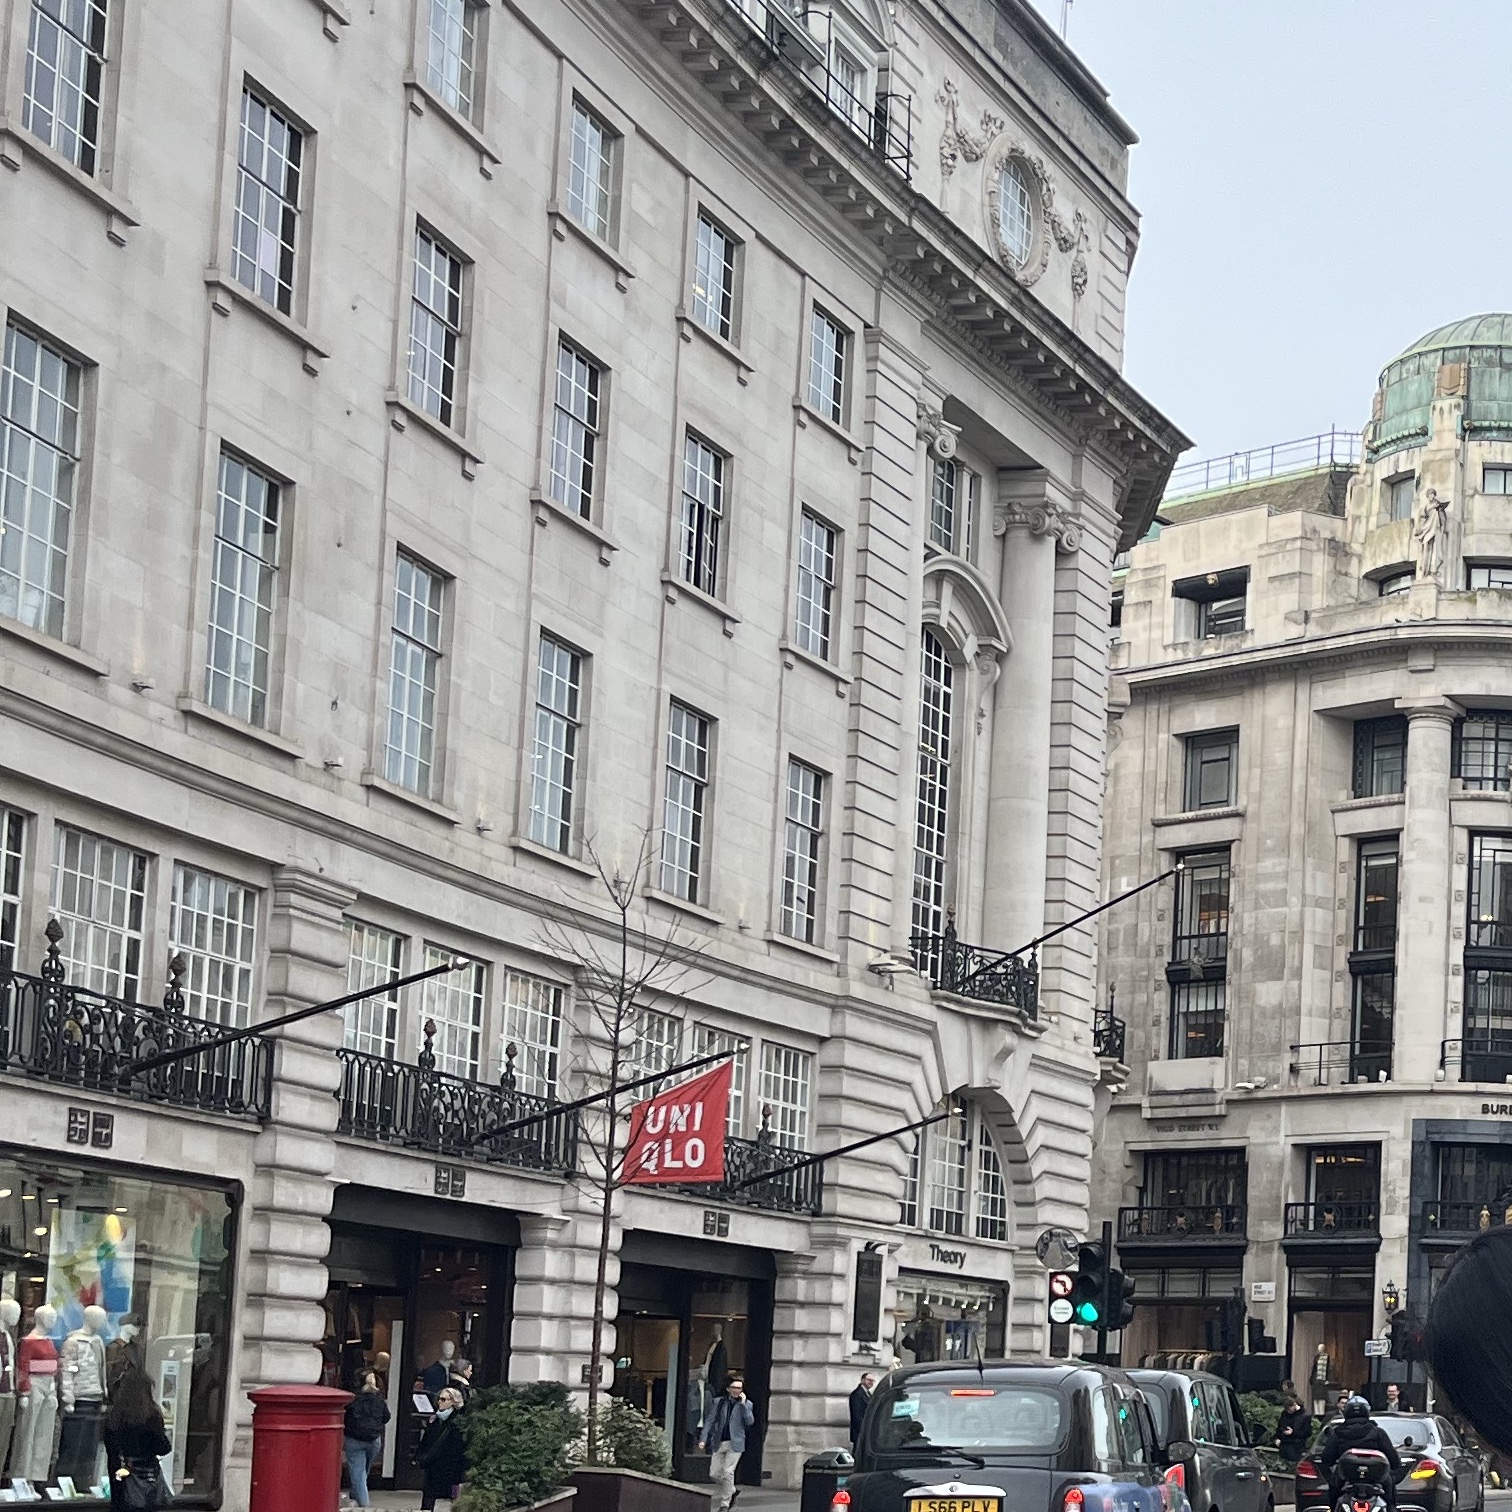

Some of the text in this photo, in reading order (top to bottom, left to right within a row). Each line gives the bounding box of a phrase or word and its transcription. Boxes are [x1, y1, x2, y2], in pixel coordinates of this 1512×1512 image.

[646, 1101, 704, 1134] UNI
[640, 1137, 705, 1175] QLO
[929, 1243, 967, 1270] Theory
